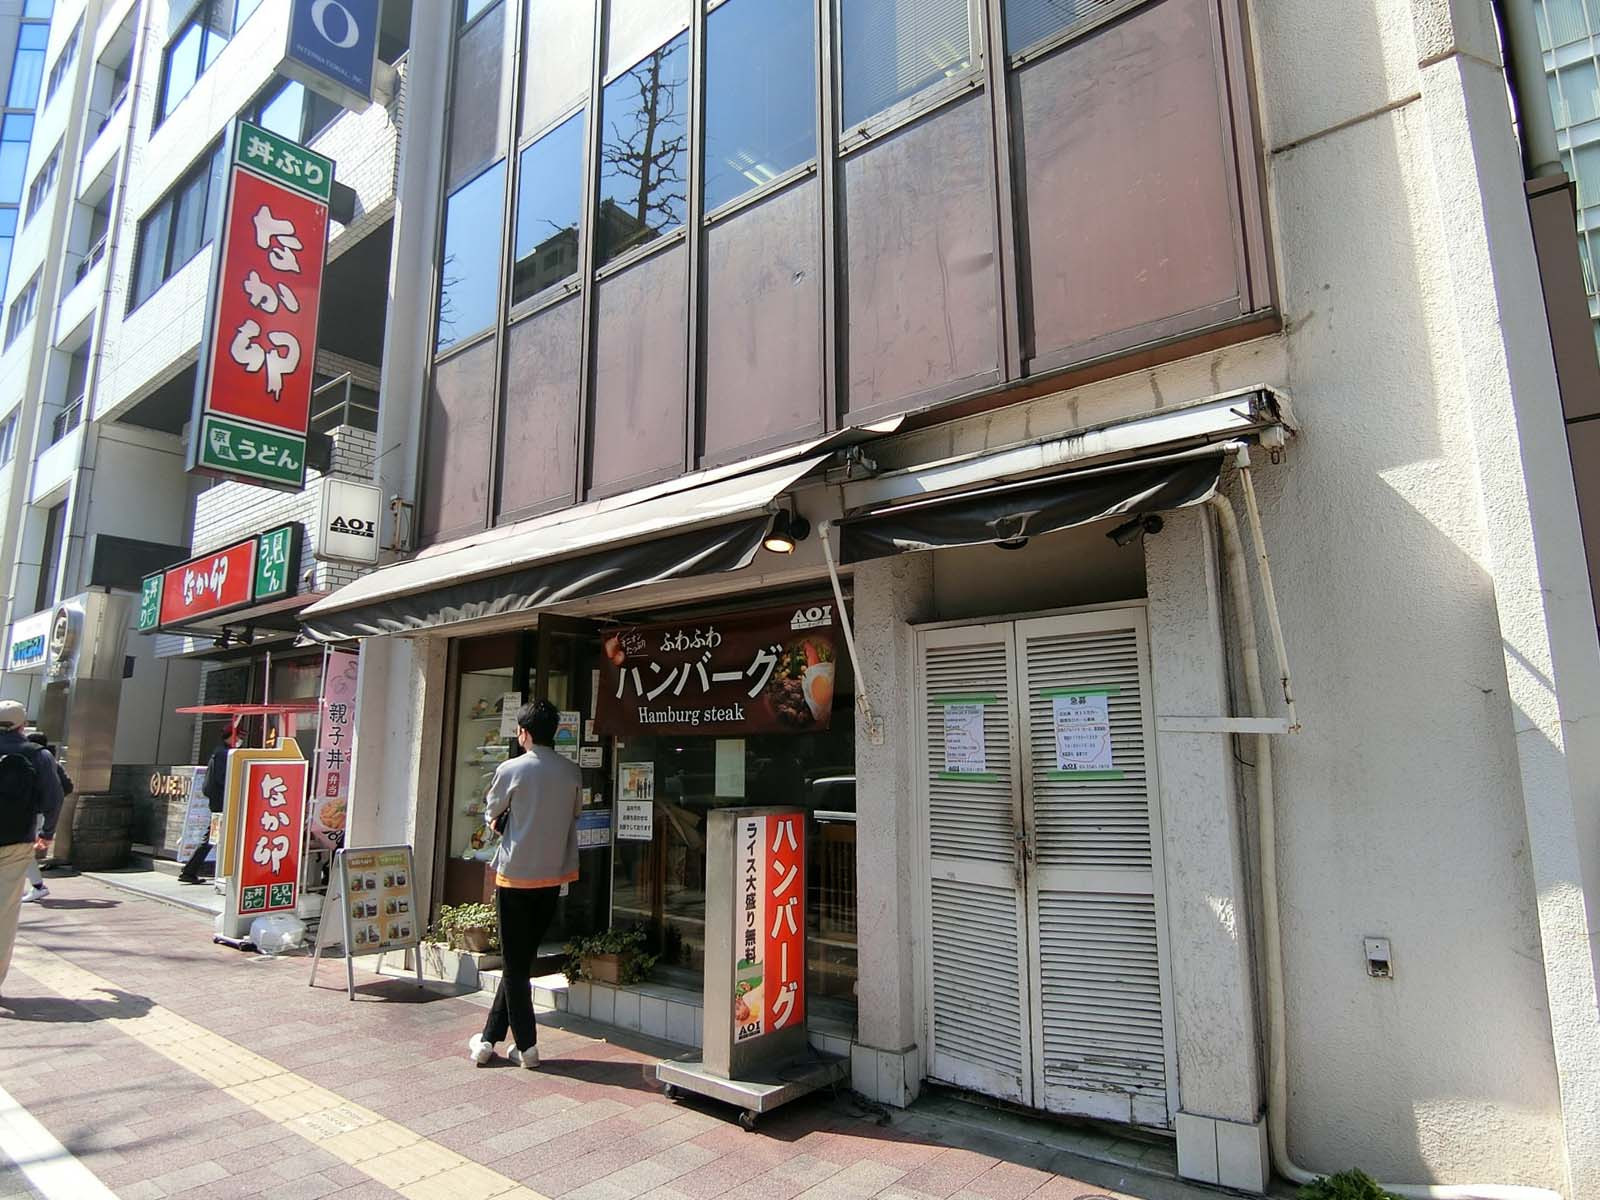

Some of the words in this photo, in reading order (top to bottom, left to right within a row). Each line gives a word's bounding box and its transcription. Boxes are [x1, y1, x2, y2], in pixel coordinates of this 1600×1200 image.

[247, 135, 324, 185] 丼ぶり
[230, 204, 303, 402] なか卯
[237, 438, 299, 470] うどん
[331, 516, 375, 532] AOI
[183, 555, 228, 605] なか卯
[260, 539, 280, 592] うどん
[660, 626, 722, 652] ふわふわ
[790, 605, 832, 624] AOI
[615, 644, 783, 702] ハンバーグ
[326, 703, 348, 770] 親子丼
[638, 706, 701, 726] Hamburg
[703, 702, 745, 722] steak
[253, 773, 290, 876] なか卯
[745, 823, 757, 964] ライス大盛り無料
[771, 820, 798, 1030] ハンバーグ
[739, 1020, 761, 1036] AOI
